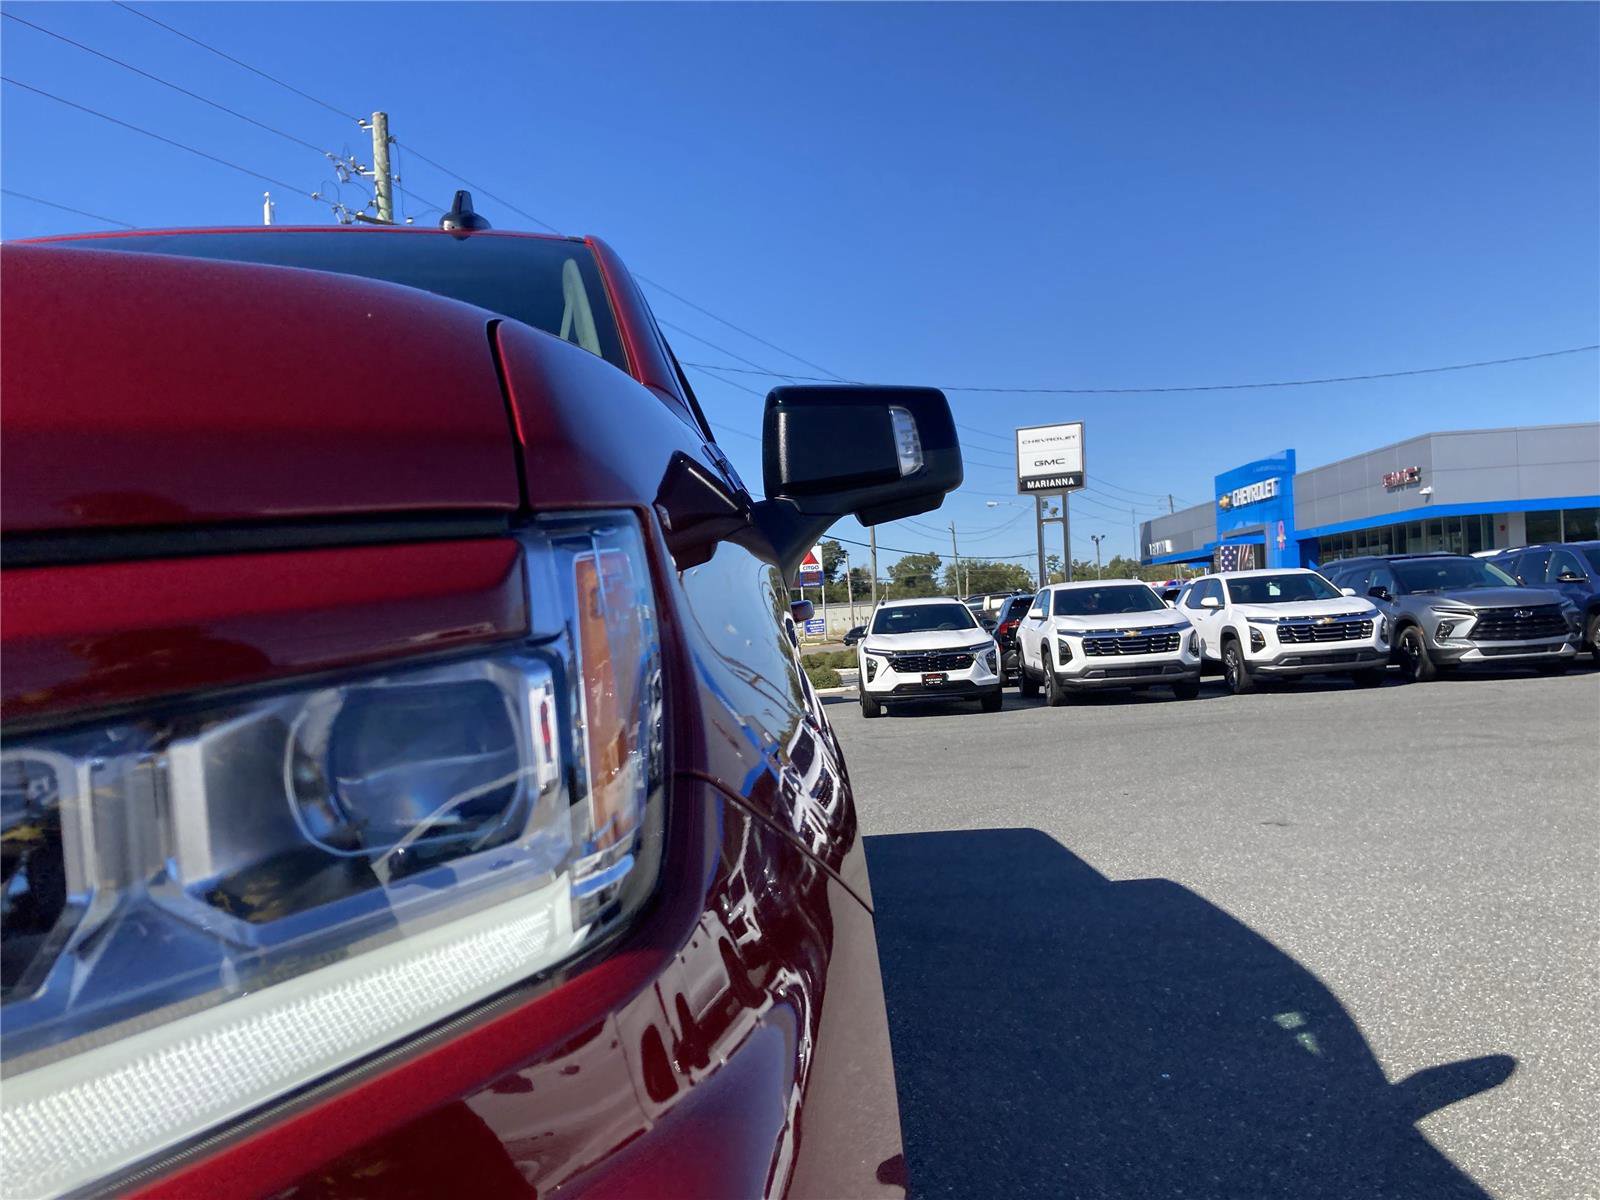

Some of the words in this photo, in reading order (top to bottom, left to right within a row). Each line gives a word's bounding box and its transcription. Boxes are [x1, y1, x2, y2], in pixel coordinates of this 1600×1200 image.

[1021, 434, 1077, 445] CHEVROLET
[1034, 458, 1066, 467] GMC
[1026, 477, 1075, 489] MARIANNA
[1231, 477, 1279, 507] CHEVROLET
